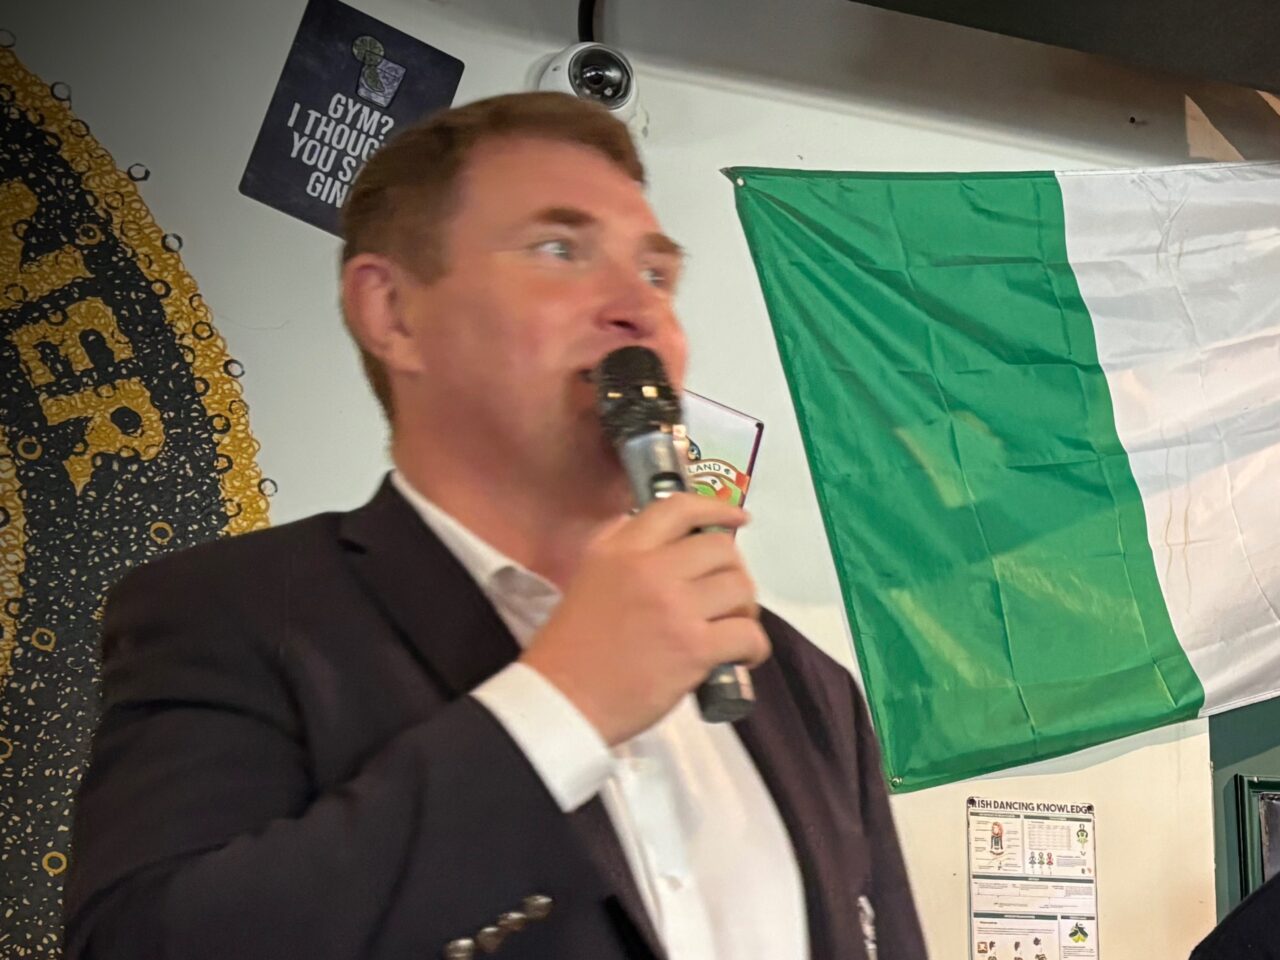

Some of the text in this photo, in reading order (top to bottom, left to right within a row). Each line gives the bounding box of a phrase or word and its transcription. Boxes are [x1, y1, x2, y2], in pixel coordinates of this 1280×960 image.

[287, 102, 382, 162] I THOUG
[328, 92, 394, 140] GYM?
[290, 131, 364, 184] YOU S
[306, 171, 349, 208] GIN
[970, 799, 1093, 814] RISH DANCING KNOWLEDG
